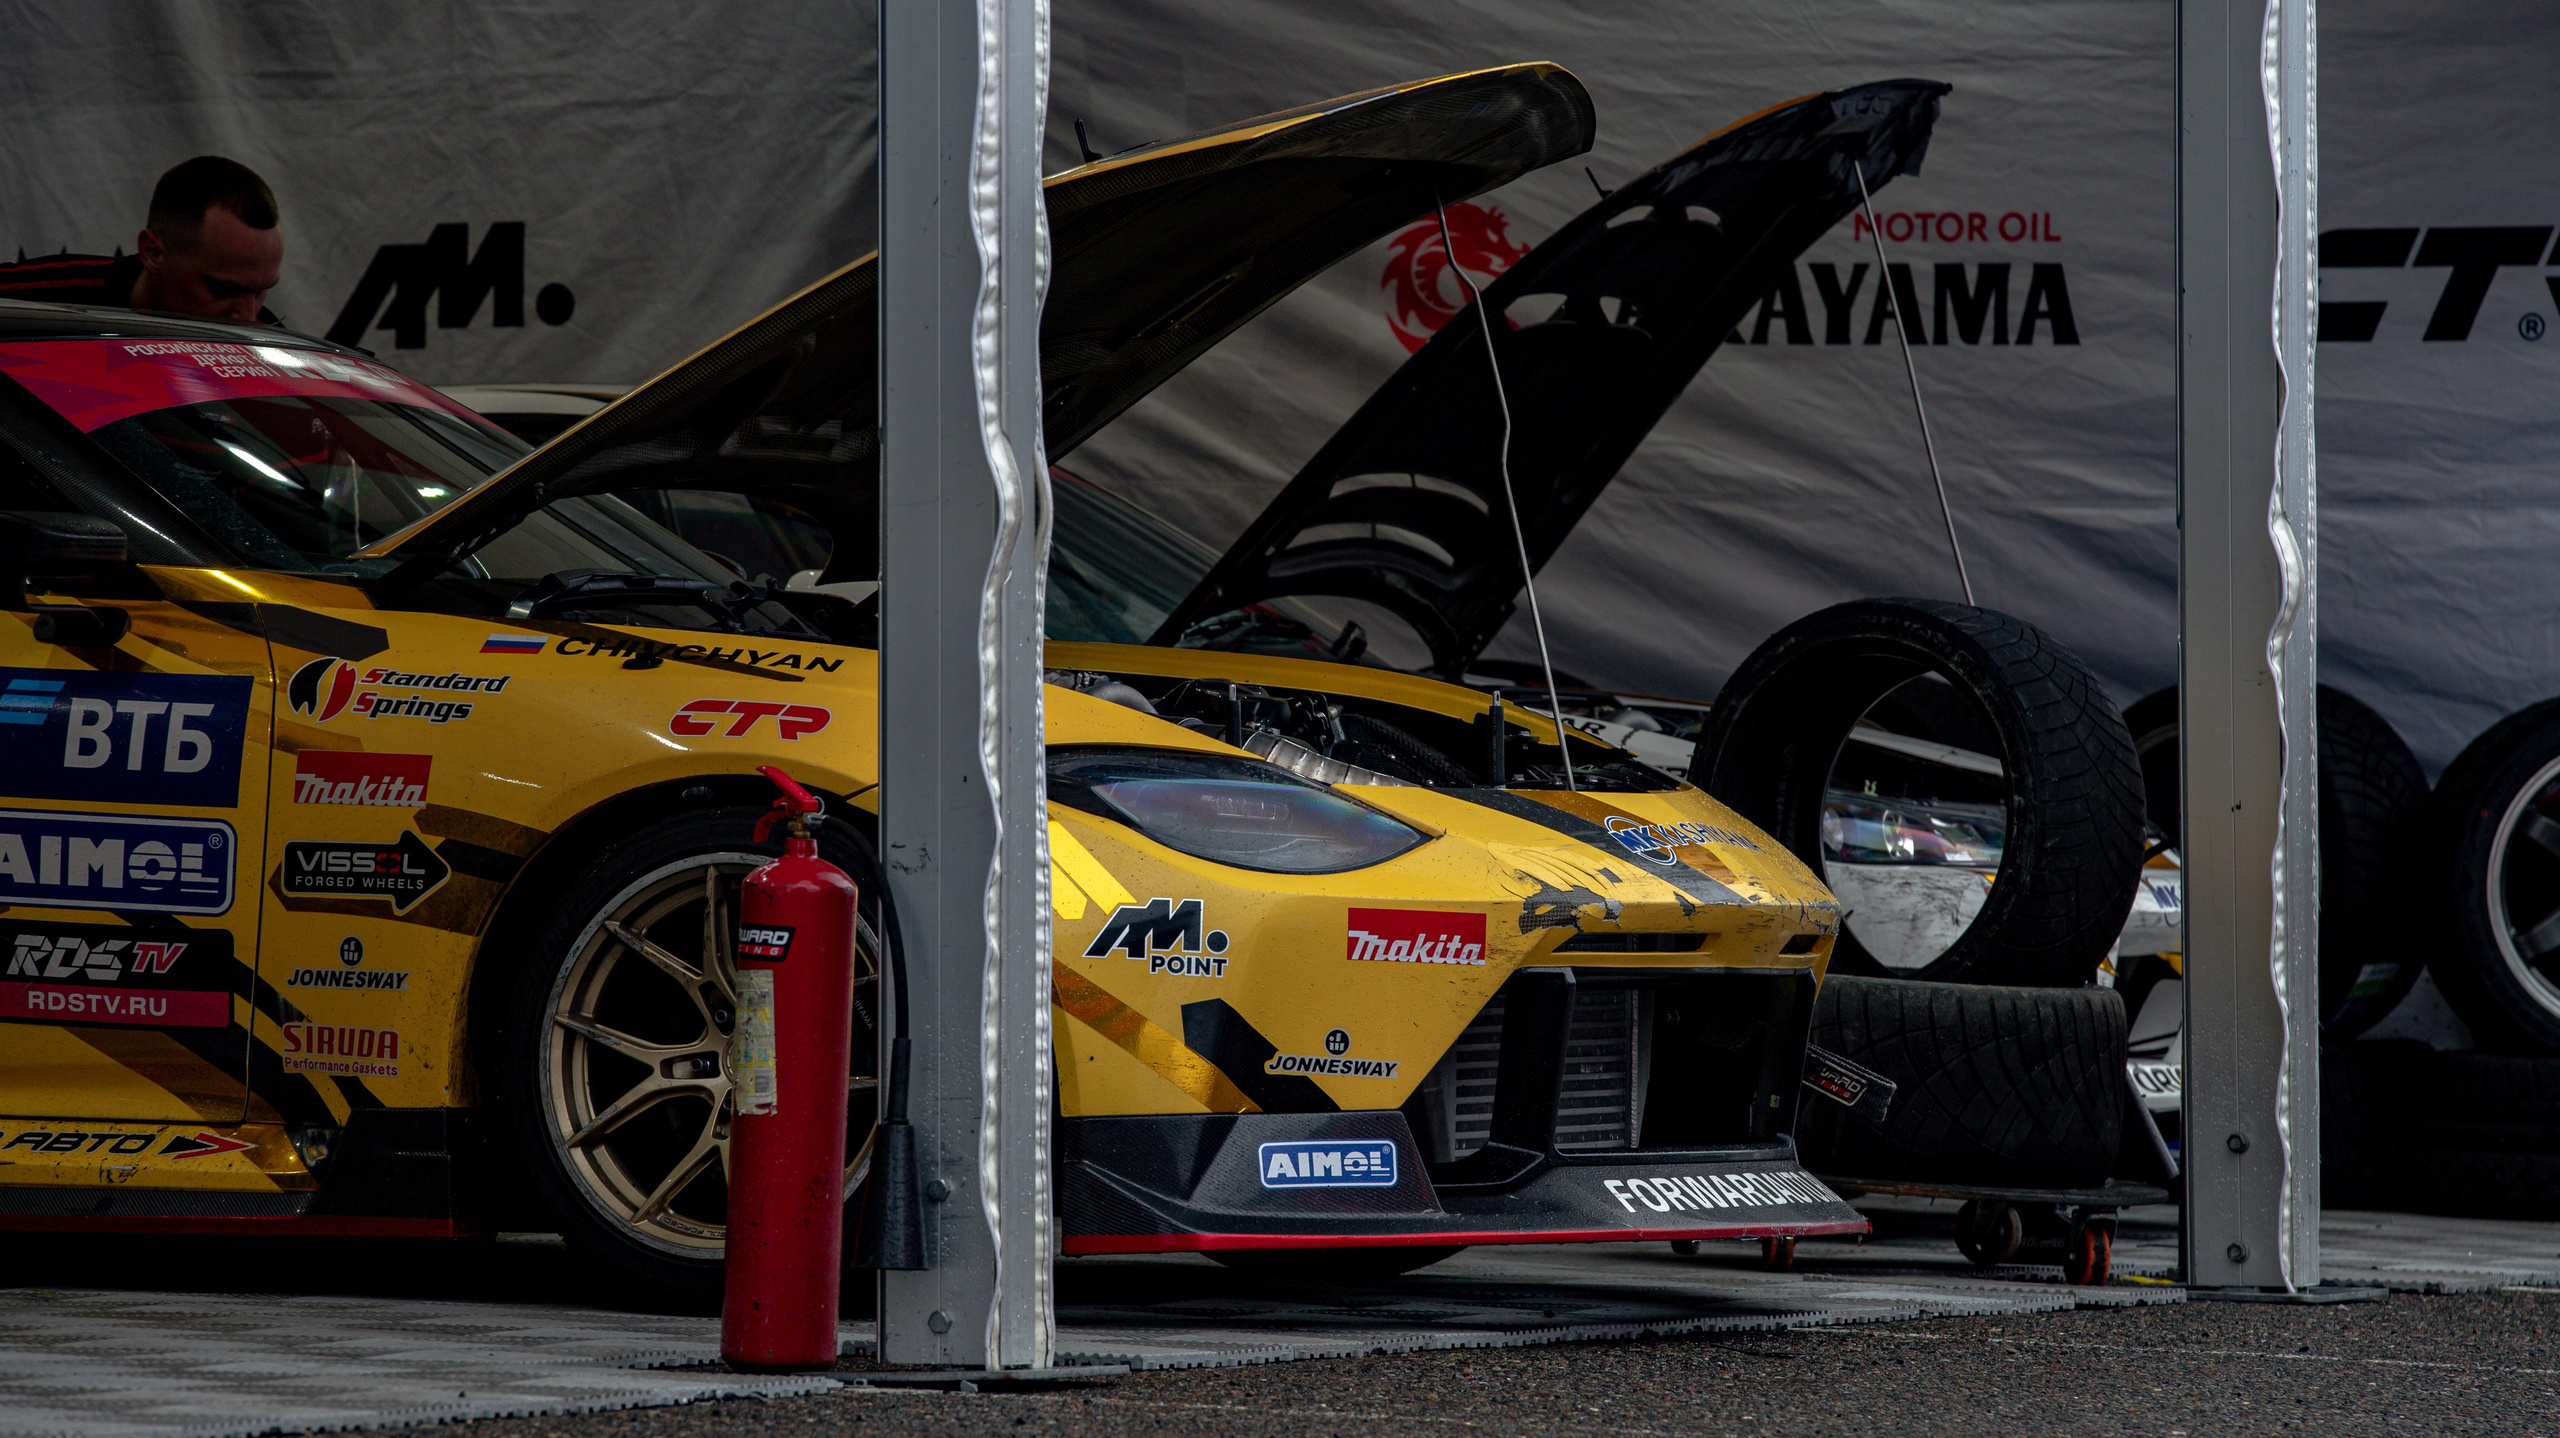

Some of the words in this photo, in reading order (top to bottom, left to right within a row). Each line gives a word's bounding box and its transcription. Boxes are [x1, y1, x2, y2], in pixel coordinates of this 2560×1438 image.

[1854, 212, 1988, 243] MOTOR
[1998, 212, 2062, 243] OIL
[2316, 225, 2560, 342] CT
[1724, 262, 2081, 345] AYAMA
[123, 341, 241, 357] РОССИЙСКАЯ
[191, 354, 255, 368] ДРИФТ
[212, 365, 274, 378] СЕРИЯ
[555, 636, 845, 673] CHIVCHYAN
[360, 668, 511, 693] Standard
[352, 690, 474, 724] Springs
[63, 697, 215, 774] ВТБ
[296, 850, 426, 875] VISSOL
[295, 875, 355, 888] FORGED
[362, 877, 424, 890] WHEELS
[130, 941, 189, 974] TV
[1151, 956, 1228, 978] POINT
[287, 969, 409, 990] JONNESWAY
[27, 990, 168, 1017] RDSTV.RU
[283, 1024, 399, 1060] SIRUDA
[284, 1057, 350, 1073] Performance
[352, 1061, 398, 1077] Gaskets
[1269, 1056, 1398, 1078] JONNESWAY
[2, 1132, 157, 1154] АВТО
